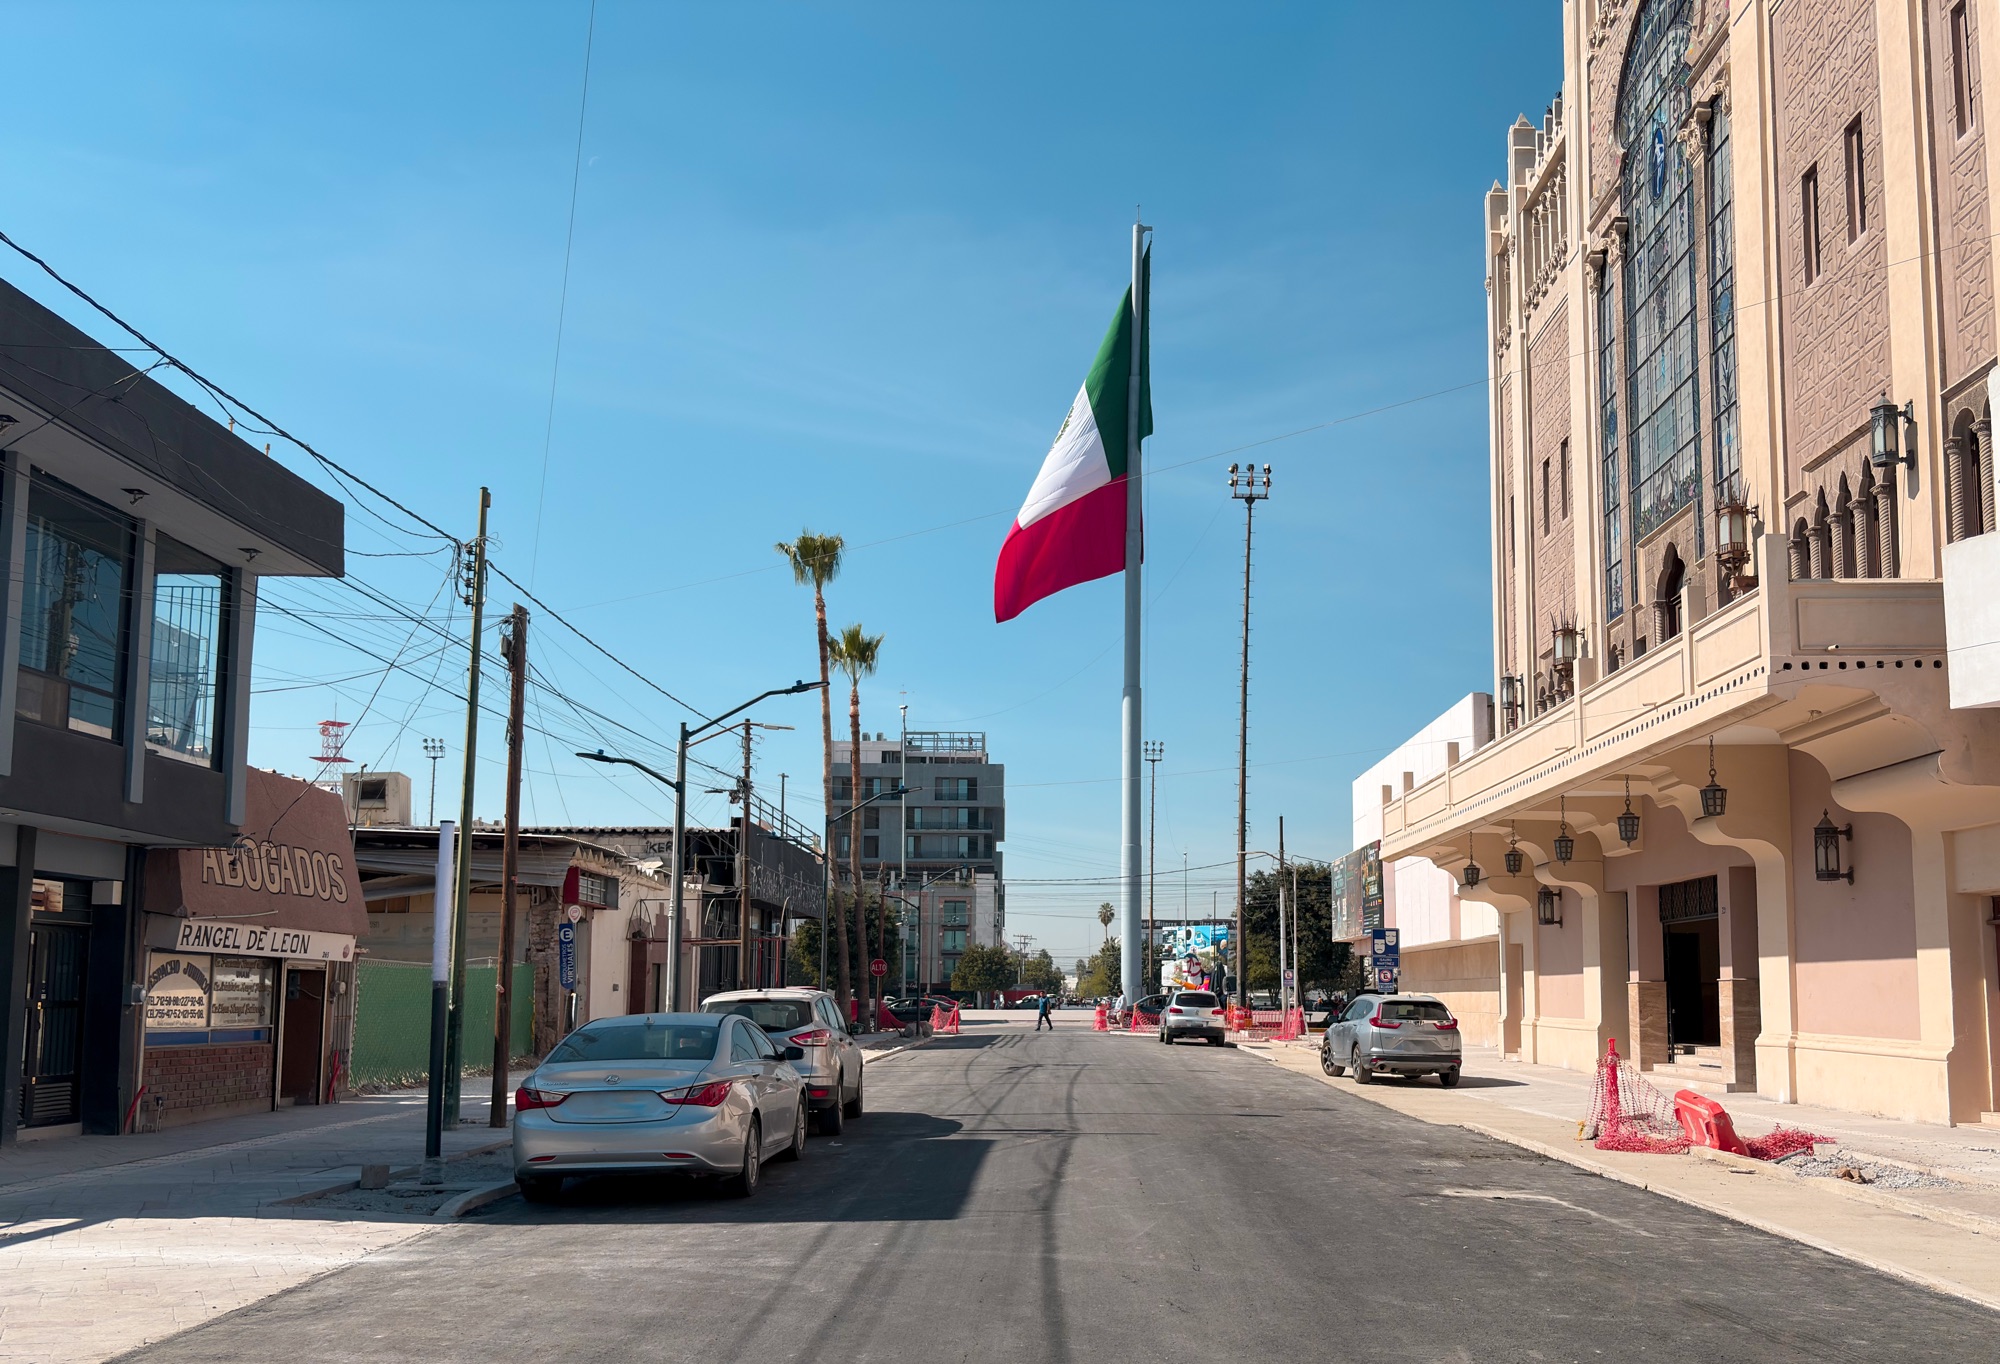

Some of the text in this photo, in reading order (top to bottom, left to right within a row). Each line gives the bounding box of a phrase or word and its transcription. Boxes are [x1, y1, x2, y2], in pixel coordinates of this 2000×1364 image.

[202, 838, 348, 903] ABOGADOS
[180, 924, 311, 954] RANGEL DE LEON
[871, 963, 887, 971] ALTO
